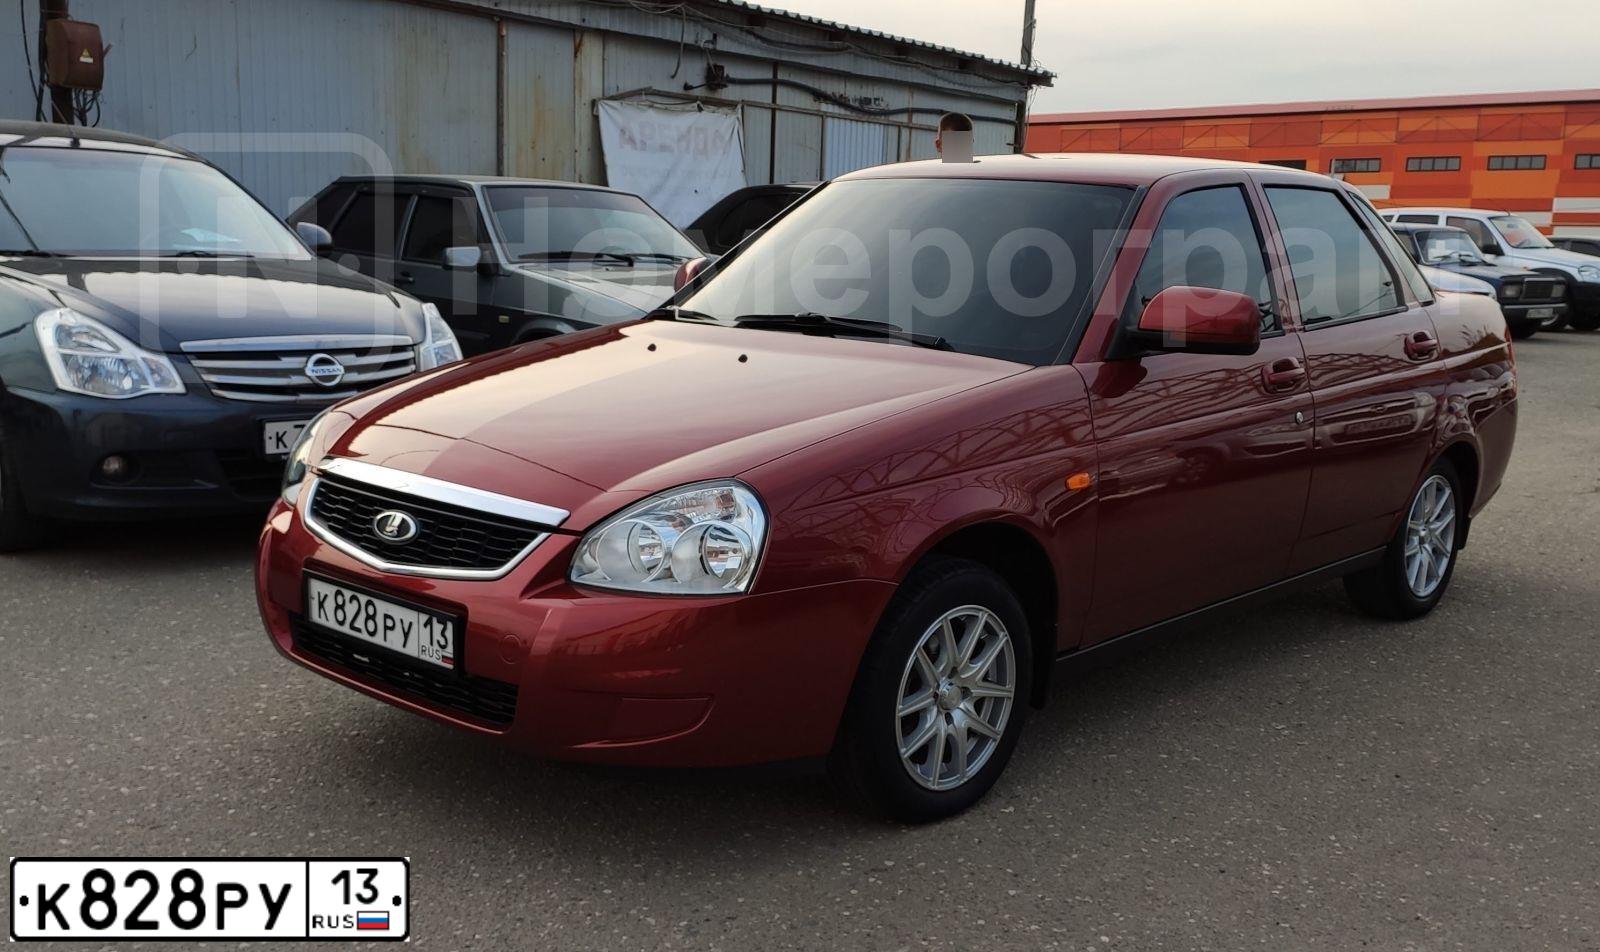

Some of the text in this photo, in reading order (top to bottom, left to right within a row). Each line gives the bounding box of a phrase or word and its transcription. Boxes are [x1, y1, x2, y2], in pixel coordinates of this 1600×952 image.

[311, 367, 342, 375] NISSAN
[317, 589, 448, 650] К828РУ 13
[421, 644, 442, 661] RUS
